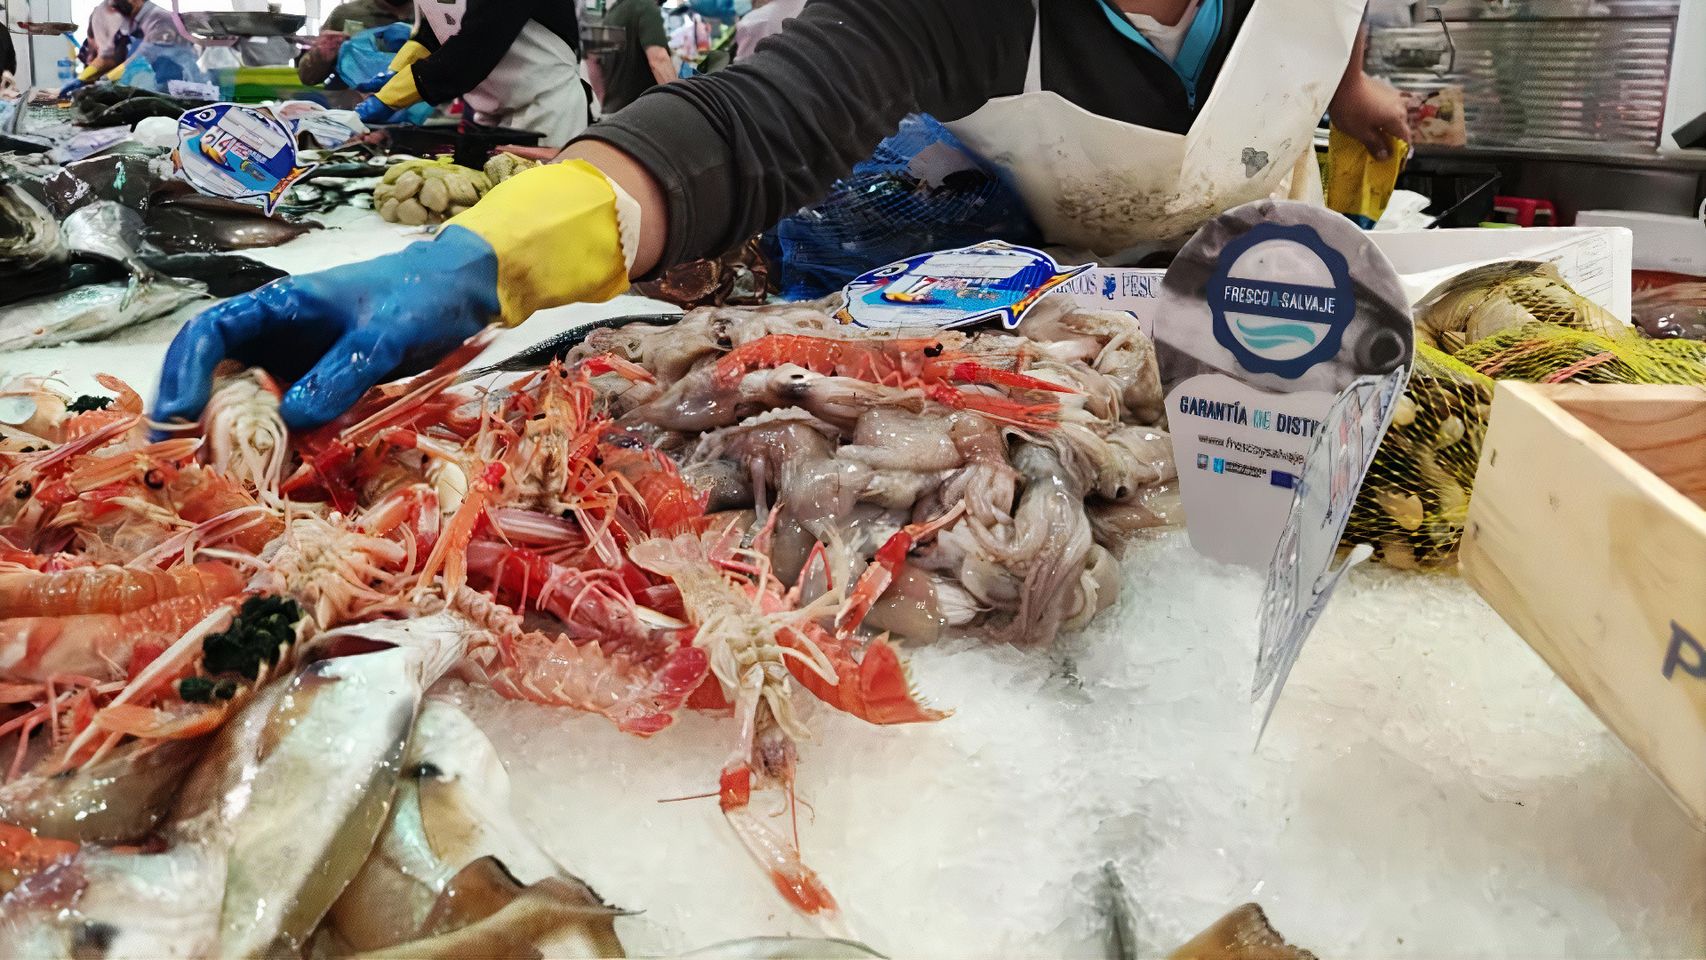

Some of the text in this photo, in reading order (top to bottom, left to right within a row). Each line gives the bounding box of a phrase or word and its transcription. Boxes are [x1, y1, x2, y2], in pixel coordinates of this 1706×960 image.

[1224, 285, 1270, 306] FRESCO
[1281, 292, 1336, 314] SALVAJE
[1179, 395, 1248, 426] GARANTÍA
